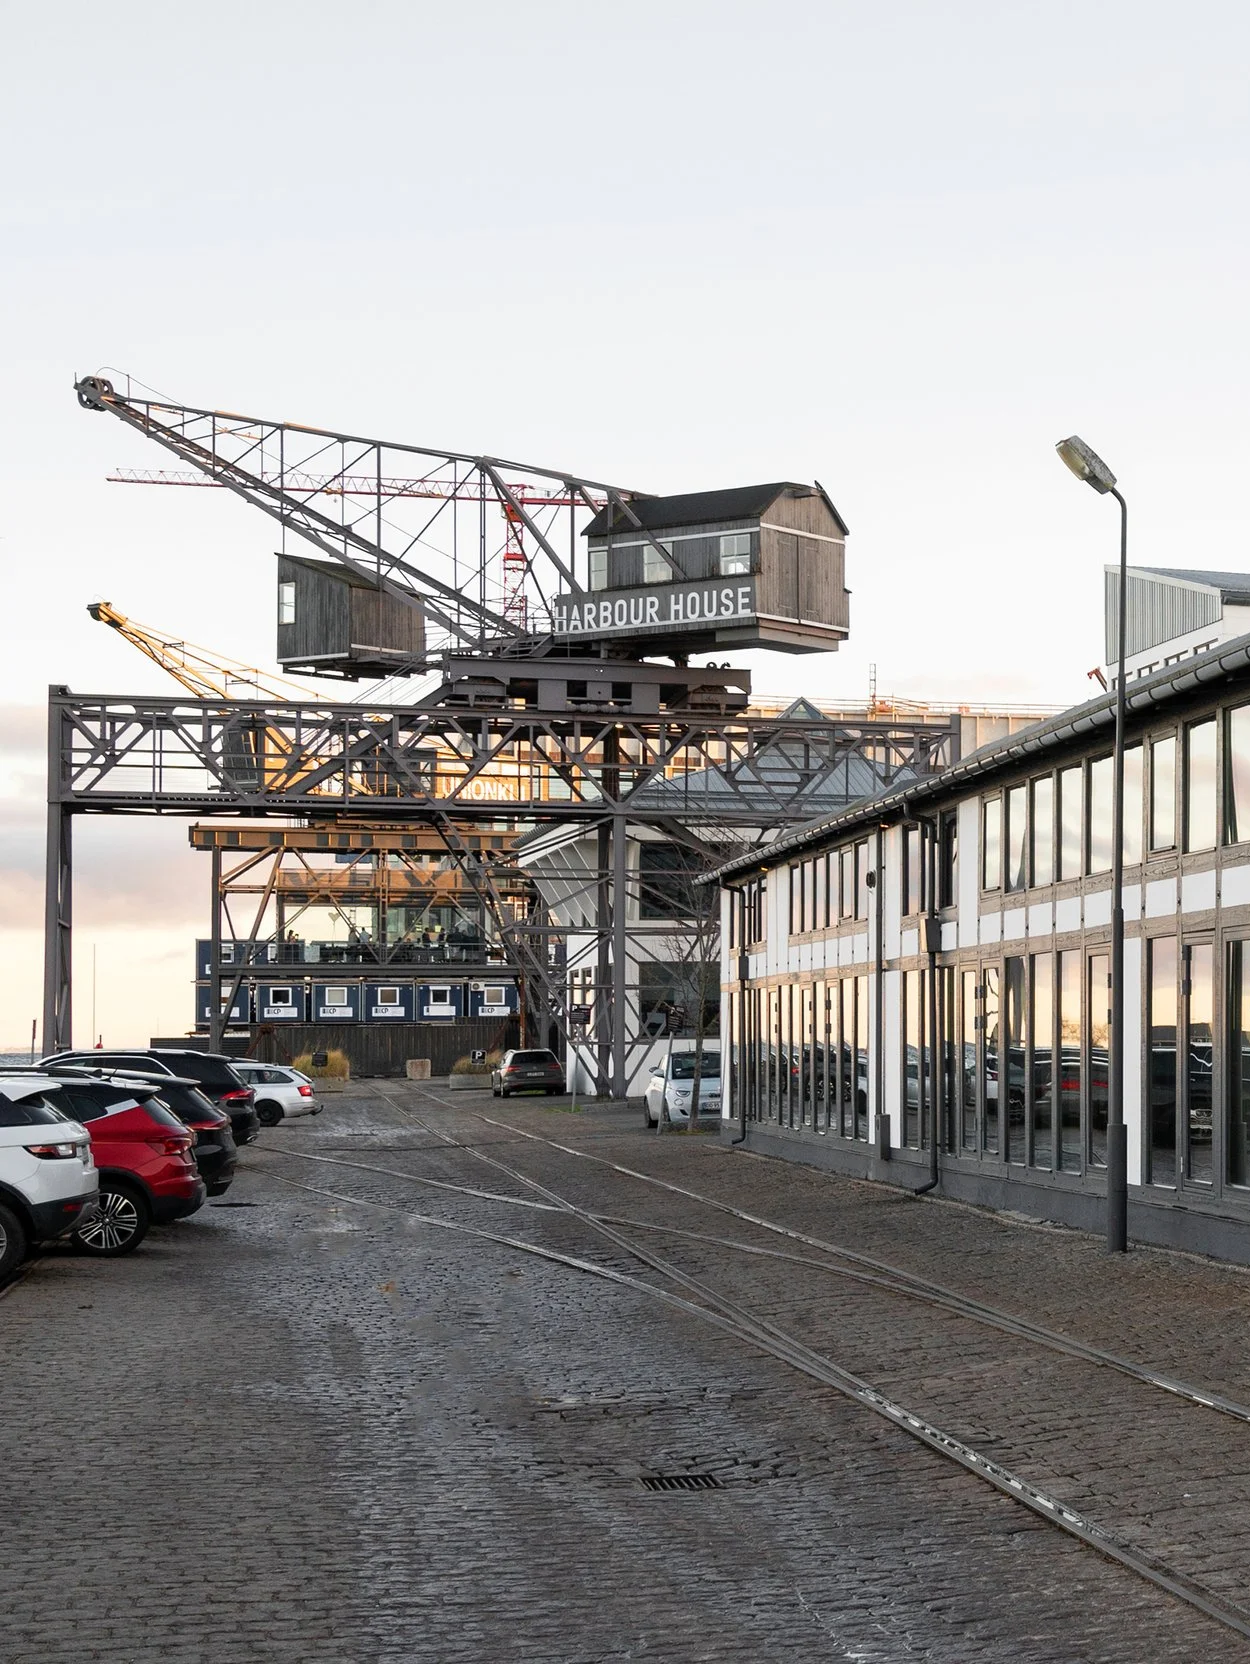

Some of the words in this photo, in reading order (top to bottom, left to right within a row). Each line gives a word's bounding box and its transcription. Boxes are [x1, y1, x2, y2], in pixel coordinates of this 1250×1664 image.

[555, 596, 660, 632] HARBOUR
[670, 587, 751, 622] HOUSE
[475, 1051, 483, 1059] P
